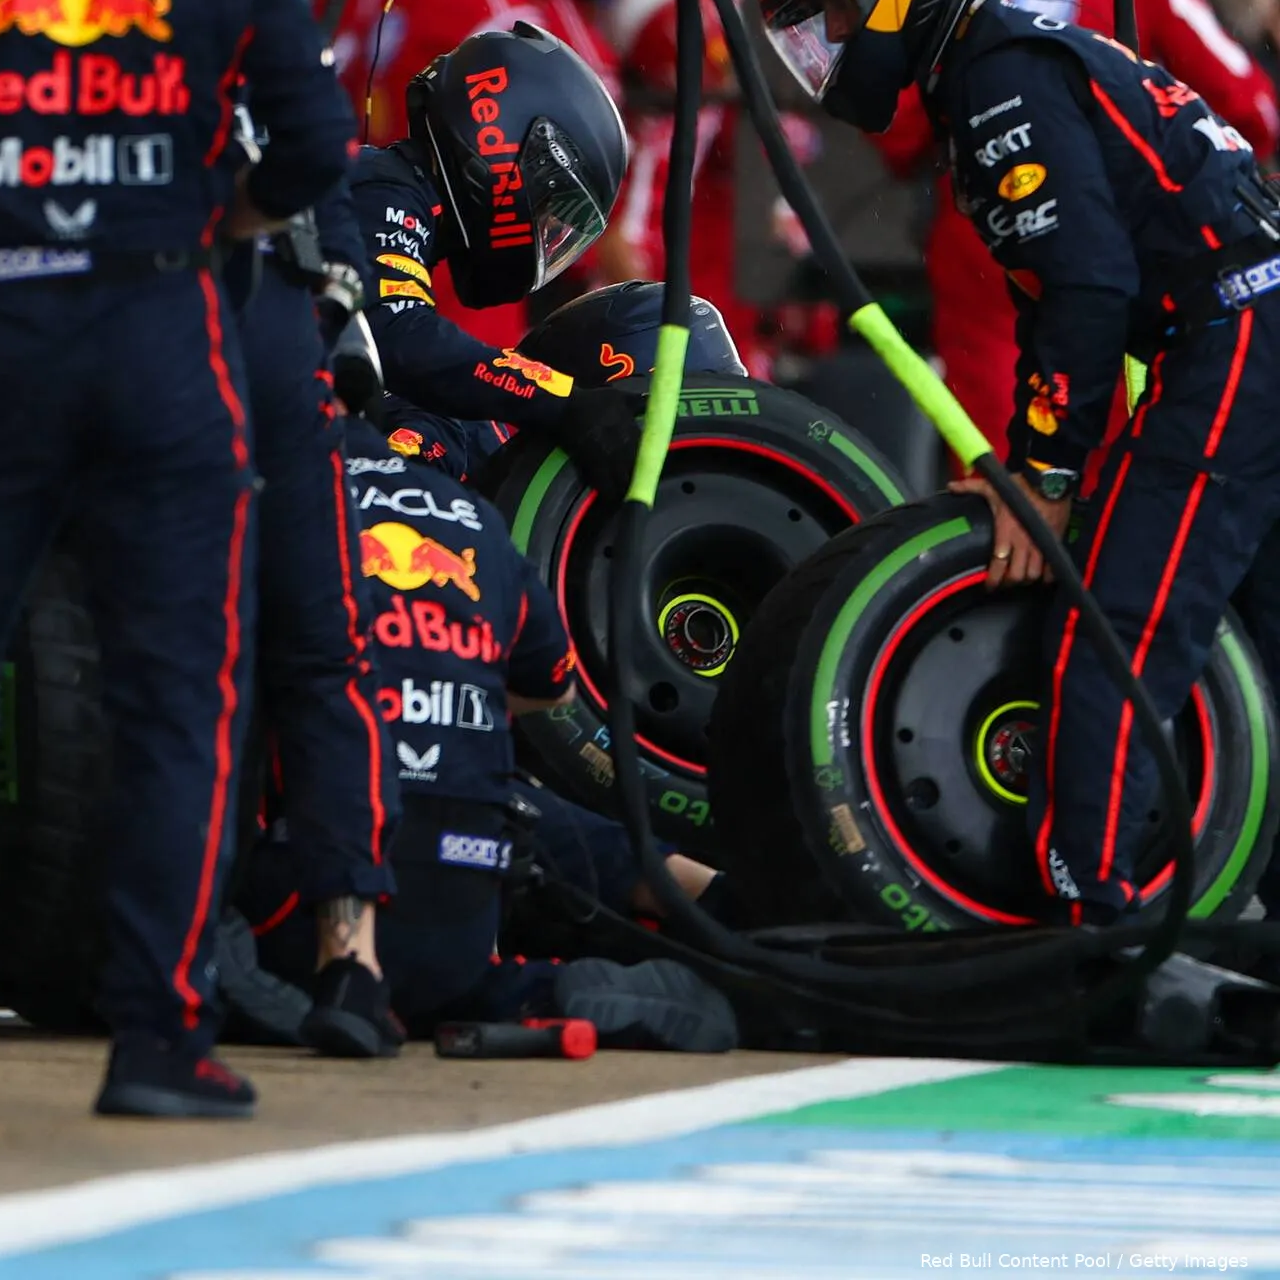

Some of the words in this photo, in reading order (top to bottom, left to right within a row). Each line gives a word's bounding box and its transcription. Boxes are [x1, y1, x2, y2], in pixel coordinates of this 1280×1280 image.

[77, 55, 190, 115] Bull
[466, 67, 520, 157] Red
[474, 363, 504, 390] Red
[503, 373, 536, 399] Bull
[352, 486, 483, 531] ACLE
[377, 679, 455, 726] obil
